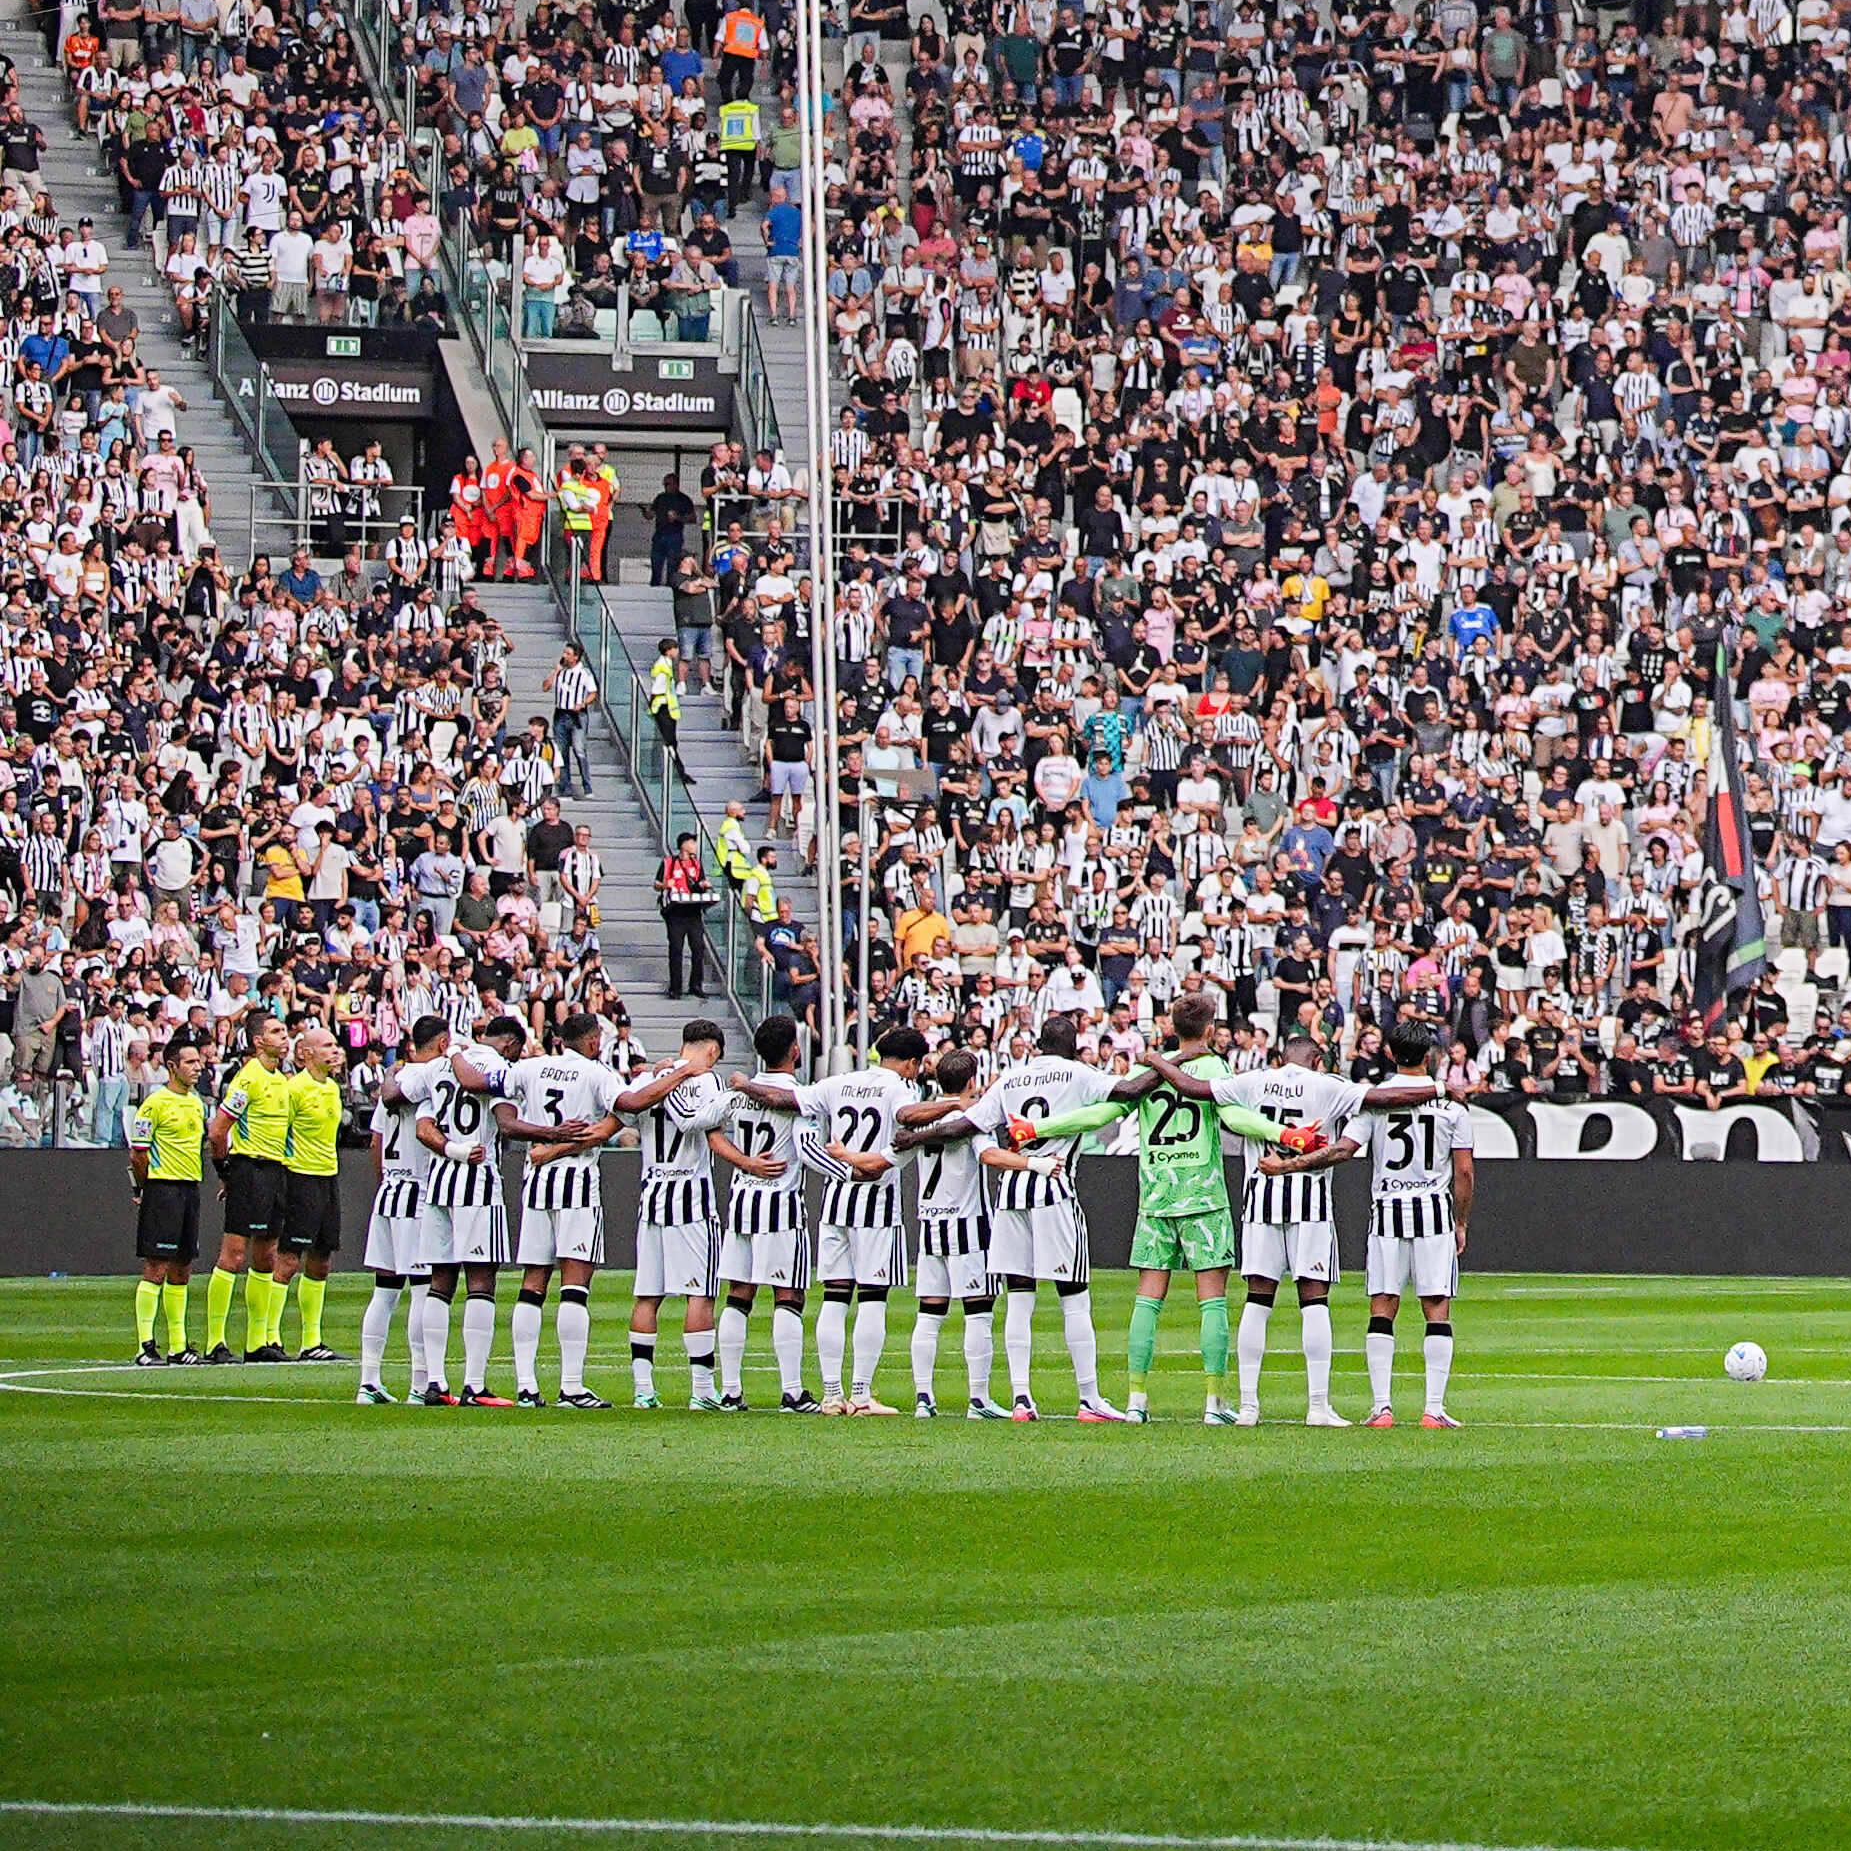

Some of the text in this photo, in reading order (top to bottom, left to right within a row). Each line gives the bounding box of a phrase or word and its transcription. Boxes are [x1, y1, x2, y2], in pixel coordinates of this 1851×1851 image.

[341, 381, 420, 403] Stadium
[528, 389, 715, 413] Allianz Stadium
[1003, 1071, 1073, 1091] KOLO MUANI
[434, 1080, 481, 1136] 26
[543, 1088, 564, 1127] 3
[1148, 1089, 1201, 1146] 25
[738, 1120, 776, 1156] 12
[837, 1105, 882, 1153] 22
[1385, 1113, 1435, 1171] 31
[923, 1142, 944, 1200] 7
[1157, 1151, 1200, 1163] Cygames
